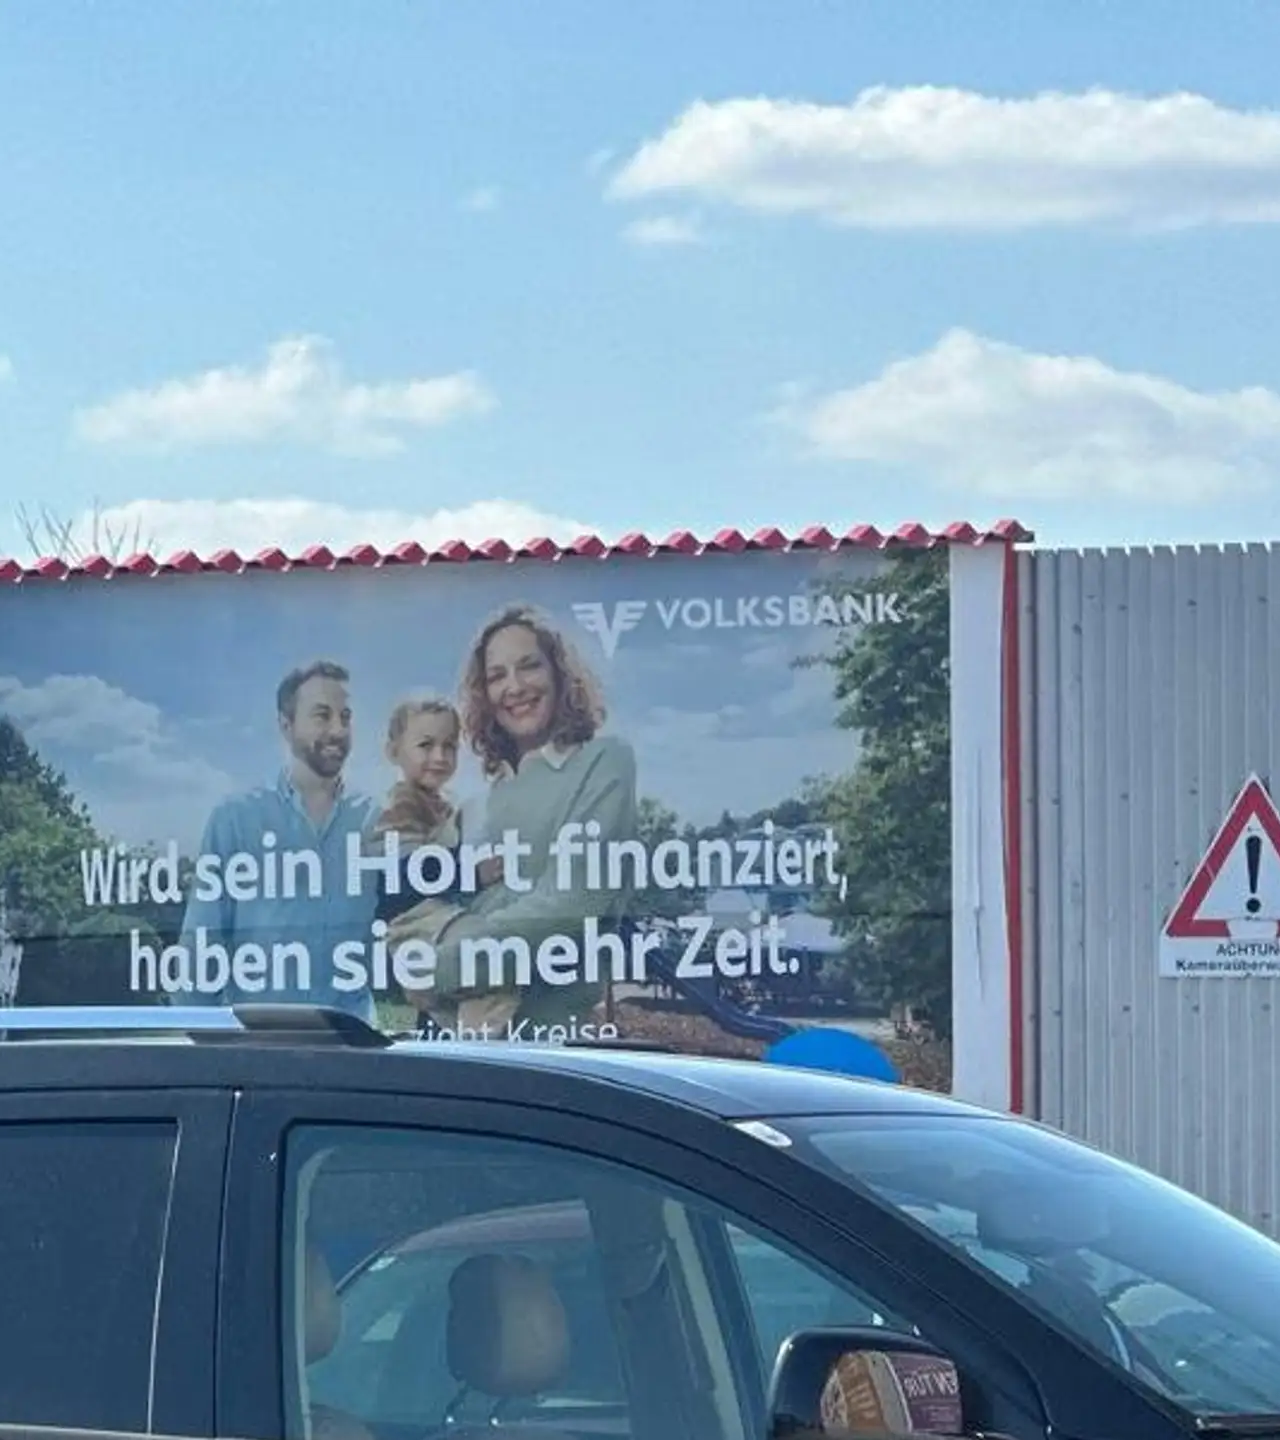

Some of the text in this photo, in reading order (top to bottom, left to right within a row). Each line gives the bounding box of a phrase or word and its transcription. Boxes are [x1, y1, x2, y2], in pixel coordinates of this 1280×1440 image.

[656, 592, 904, 630] VOLKSBANK
[80, 818, 848, 906] Wird sein Hort finanziert,
[130, 910, 801, 993] haben sie mehr Zeit.
